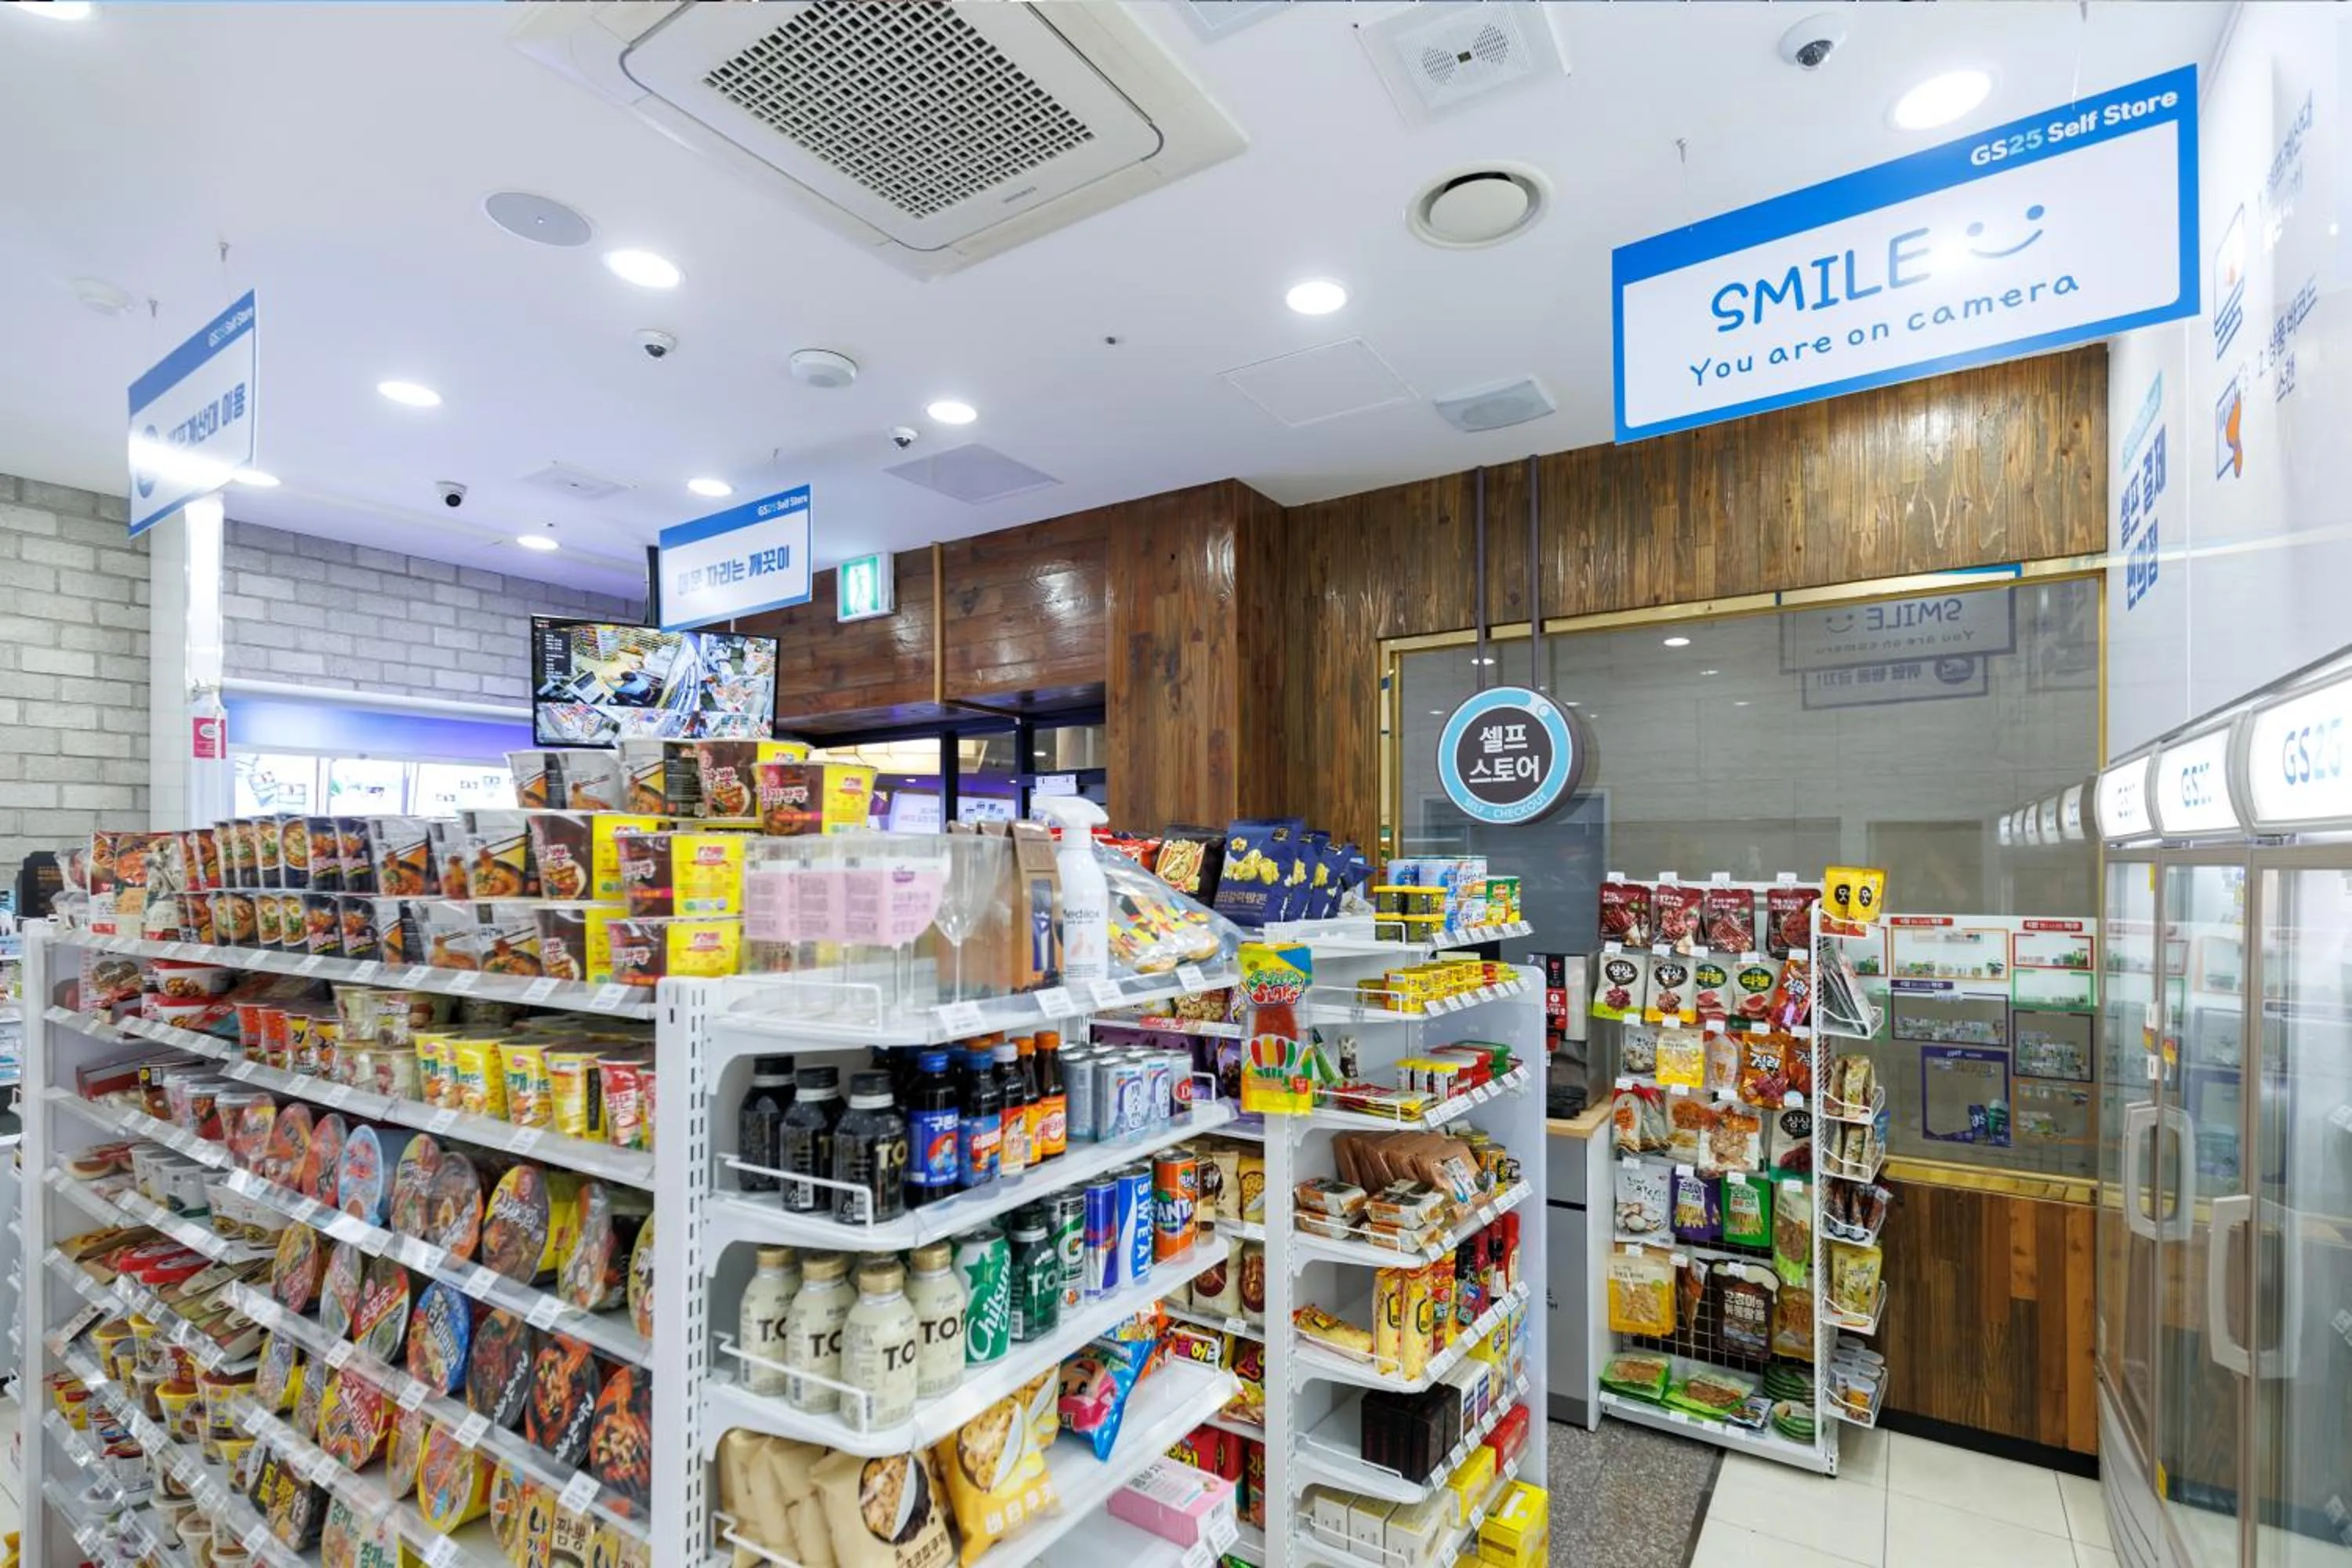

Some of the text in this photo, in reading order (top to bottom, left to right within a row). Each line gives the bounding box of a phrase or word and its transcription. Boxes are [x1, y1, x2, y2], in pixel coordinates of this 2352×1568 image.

[1969, 90, 2179, 167] GS25 Self Store
[1710, 226, 1933, 334] SMILE
[1690, 274, 2081, 387] You are on camera
[222, 383, 246, 428] 이용
[706, 557, 745, 588] 자리는
[749, 544, 790, 578] 깨끗이
[1479, 723, 1529, 754] 셀프
[1468, 754, 1541, 784] 스토어
[1136, 1181, 1152, 1277] SWEAT
[1156, 1197, 1194, 1221] ANTA
